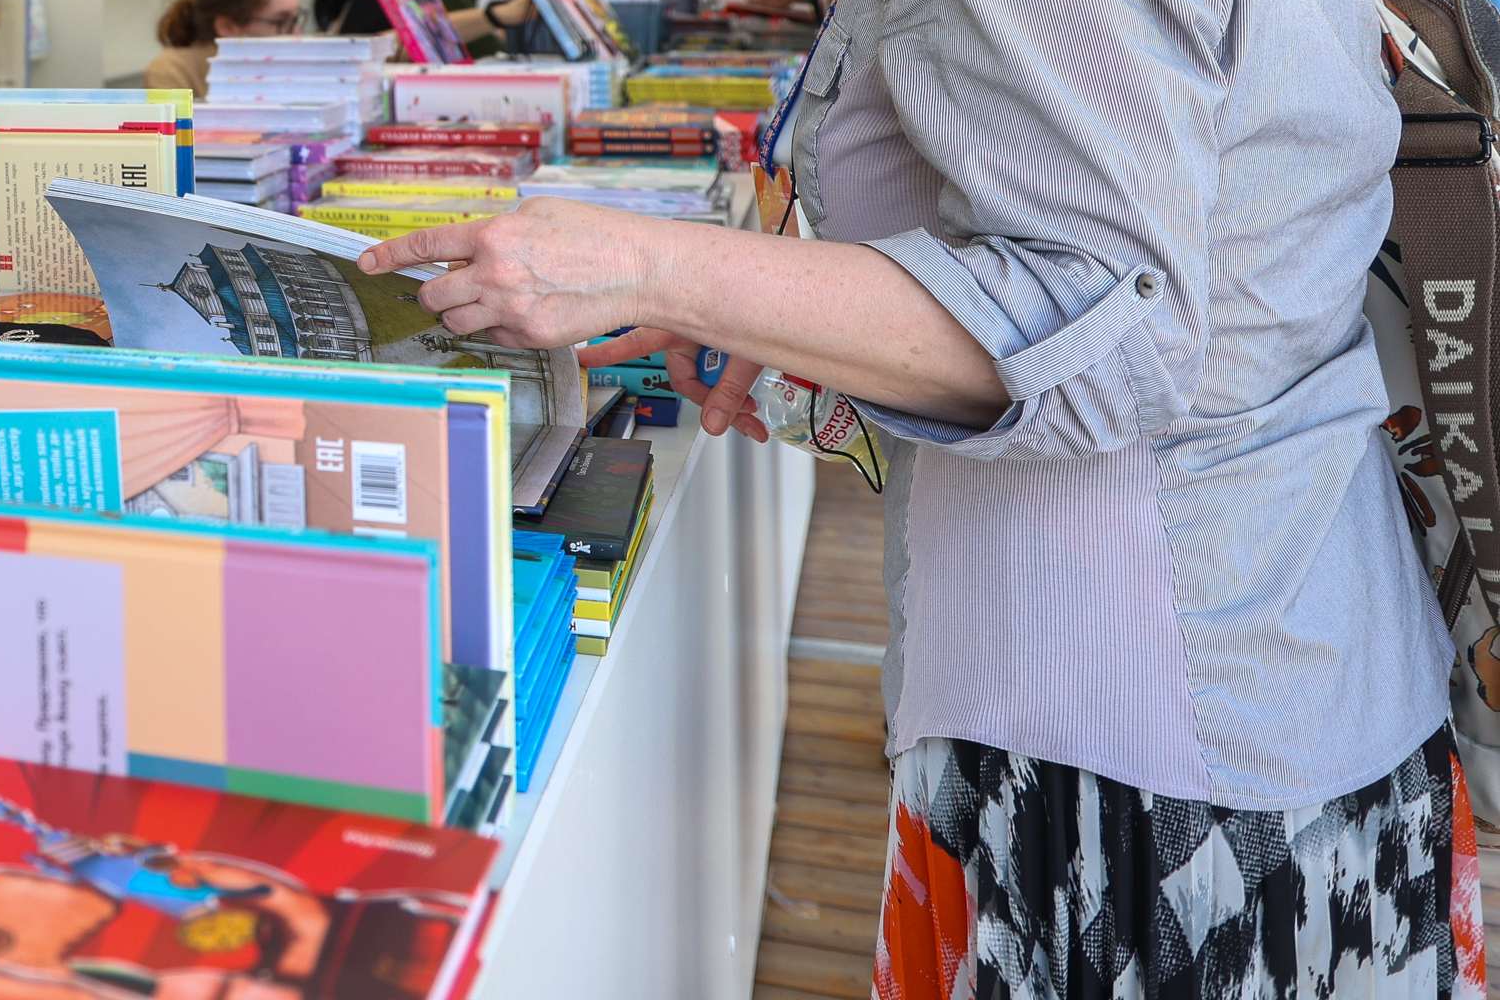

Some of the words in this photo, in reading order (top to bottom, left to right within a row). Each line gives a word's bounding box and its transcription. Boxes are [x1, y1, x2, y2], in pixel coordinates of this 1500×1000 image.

[360, 213, 391, 223] КРОВЬ
[58, 234, 63, 242] Он
[37, 258, 42, 266] Он
[1423, 279, 1500, 621] DAIKAL
